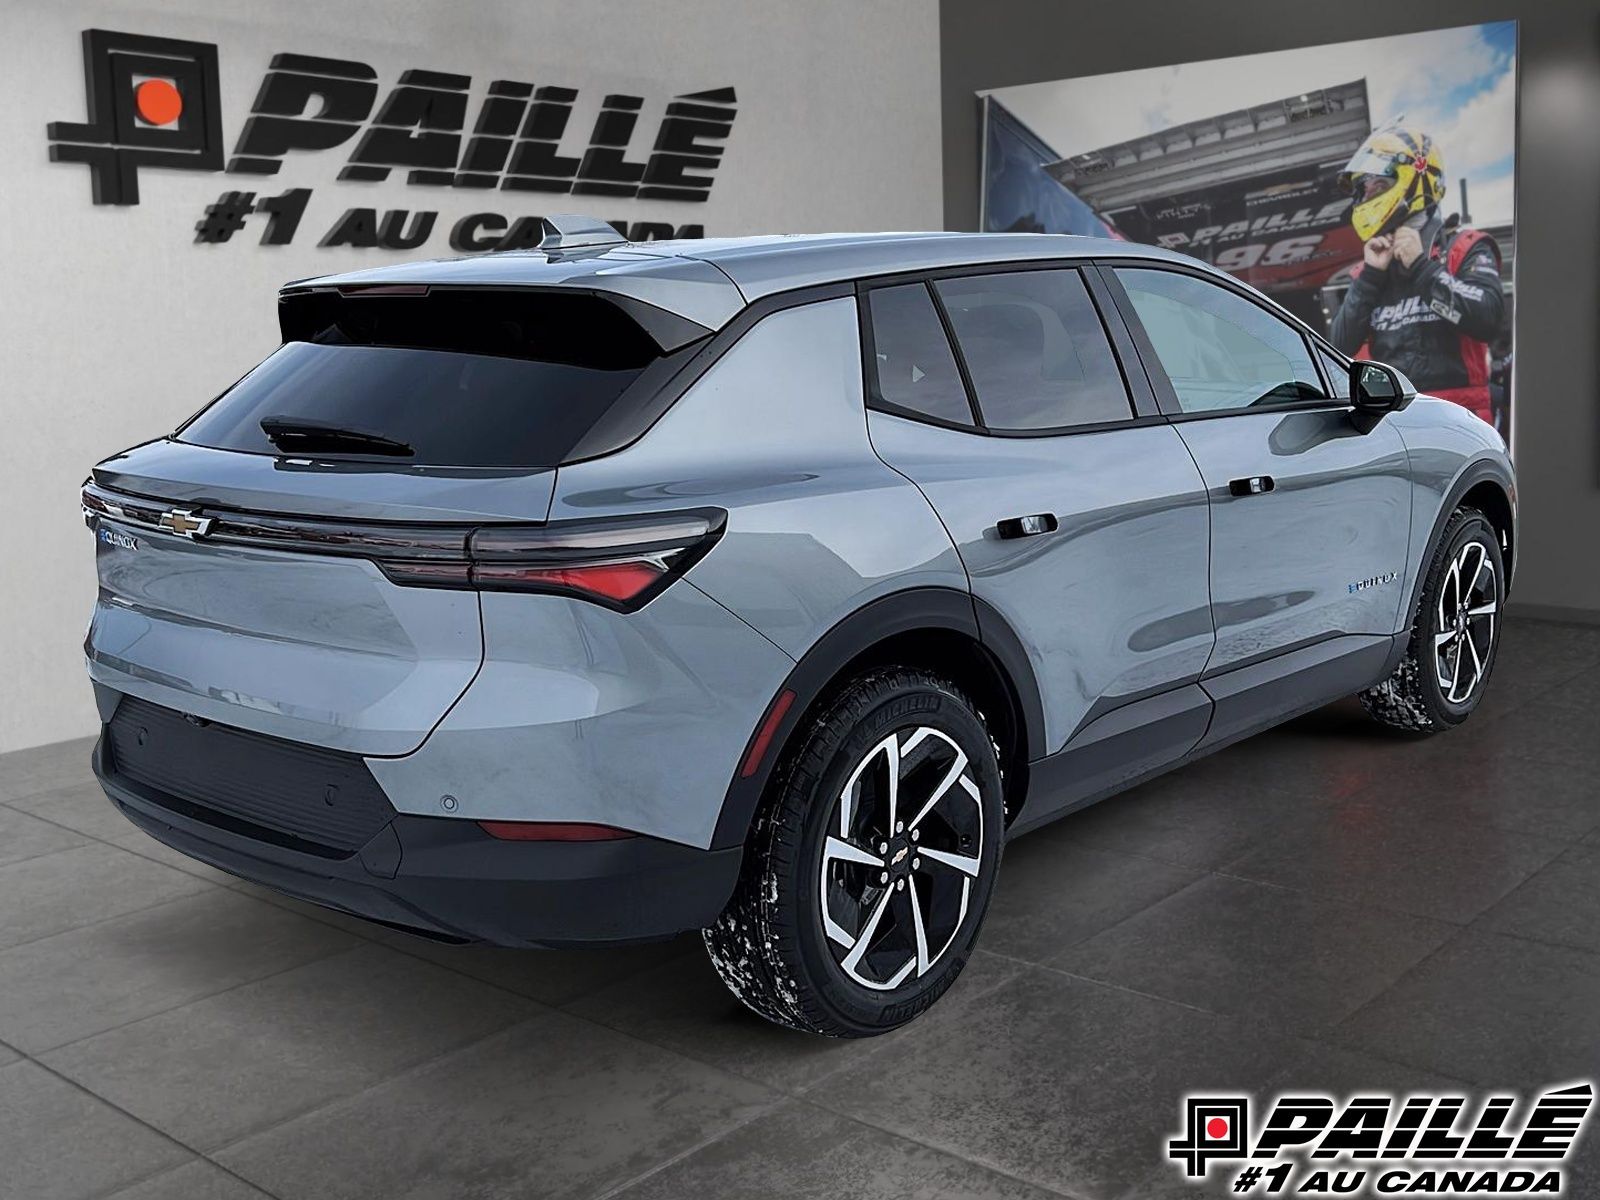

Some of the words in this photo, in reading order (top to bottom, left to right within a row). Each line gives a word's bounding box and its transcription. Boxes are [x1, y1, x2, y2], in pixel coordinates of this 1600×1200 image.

[226, 52, 737, 202] PAILLÉ
[193, 187, 313, 249] #1
[317, 208, 438, 249] AU
[1216, 234, 1323, 272] 96
